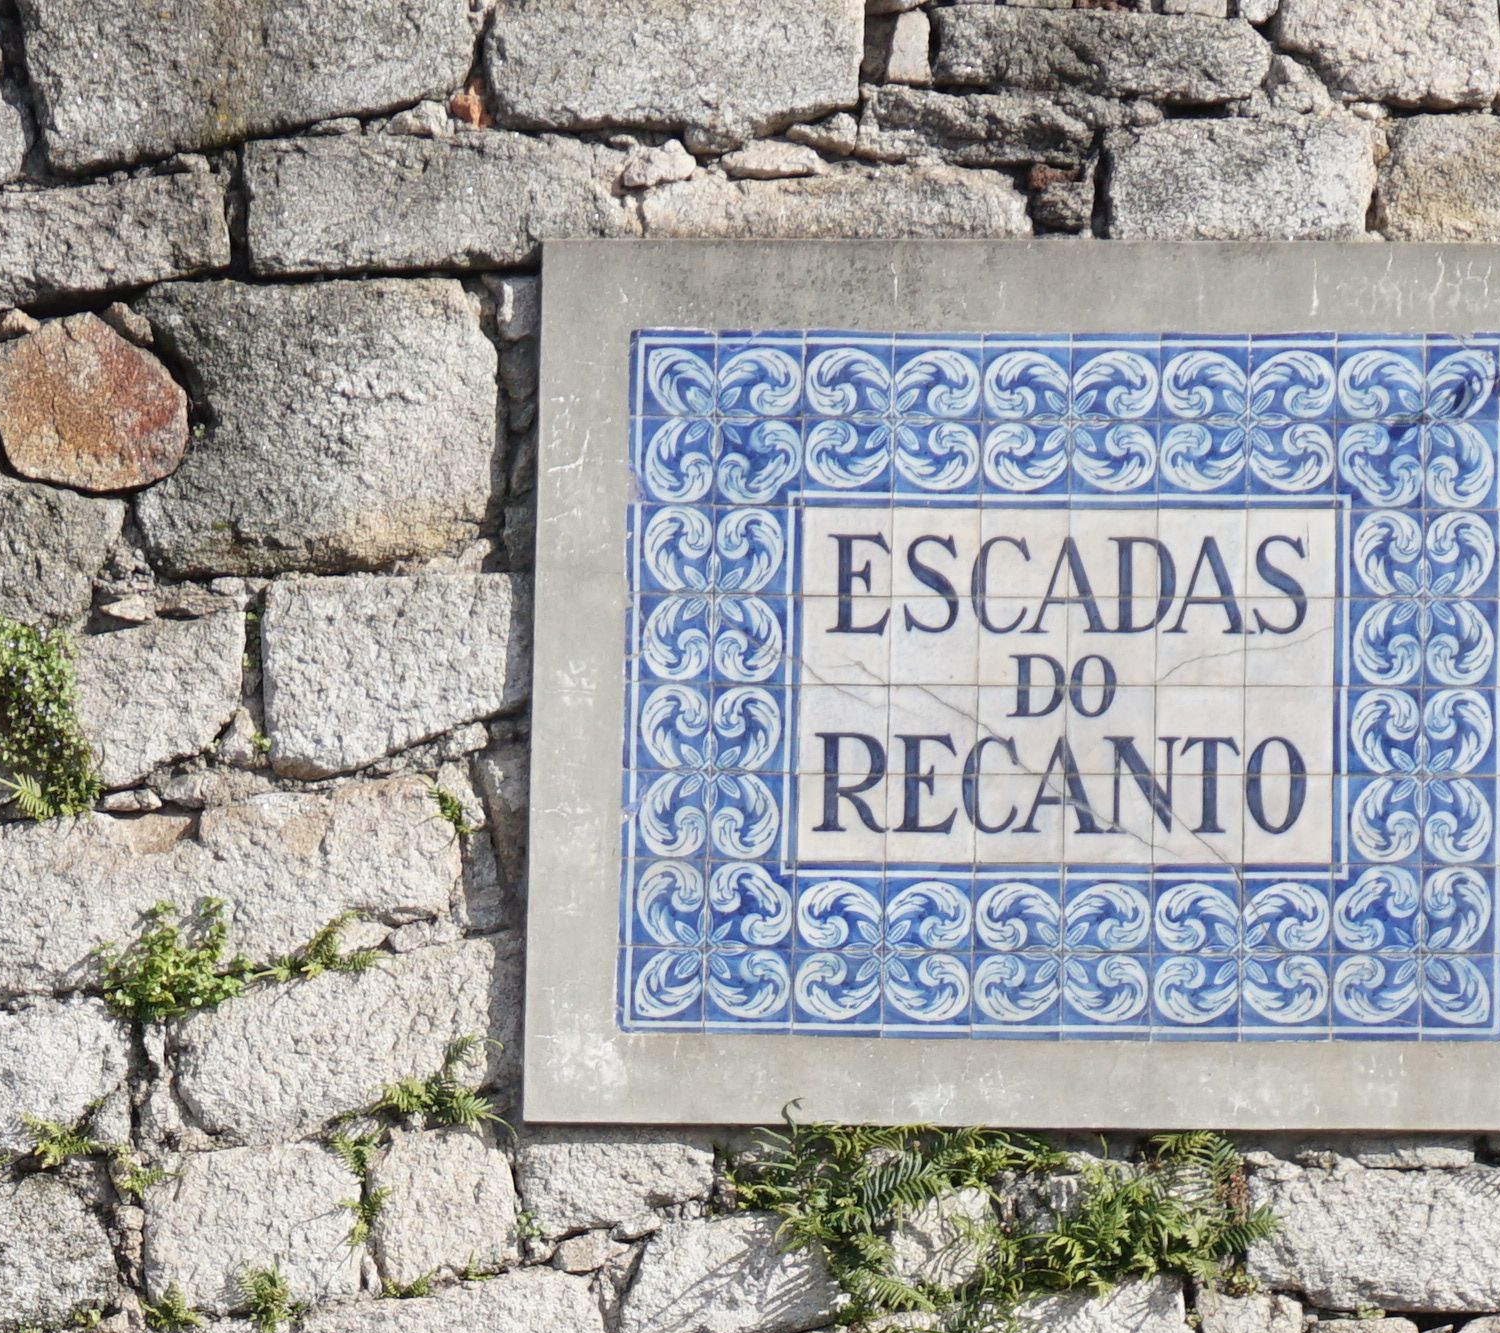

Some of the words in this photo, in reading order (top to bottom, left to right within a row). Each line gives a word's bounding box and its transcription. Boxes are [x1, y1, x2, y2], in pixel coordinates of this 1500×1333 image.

[826, 531, 1308, 636] ESCADAS
[1005, 652, 1118, 718] DO
[812, 731, 1307, 835] RECANTO
